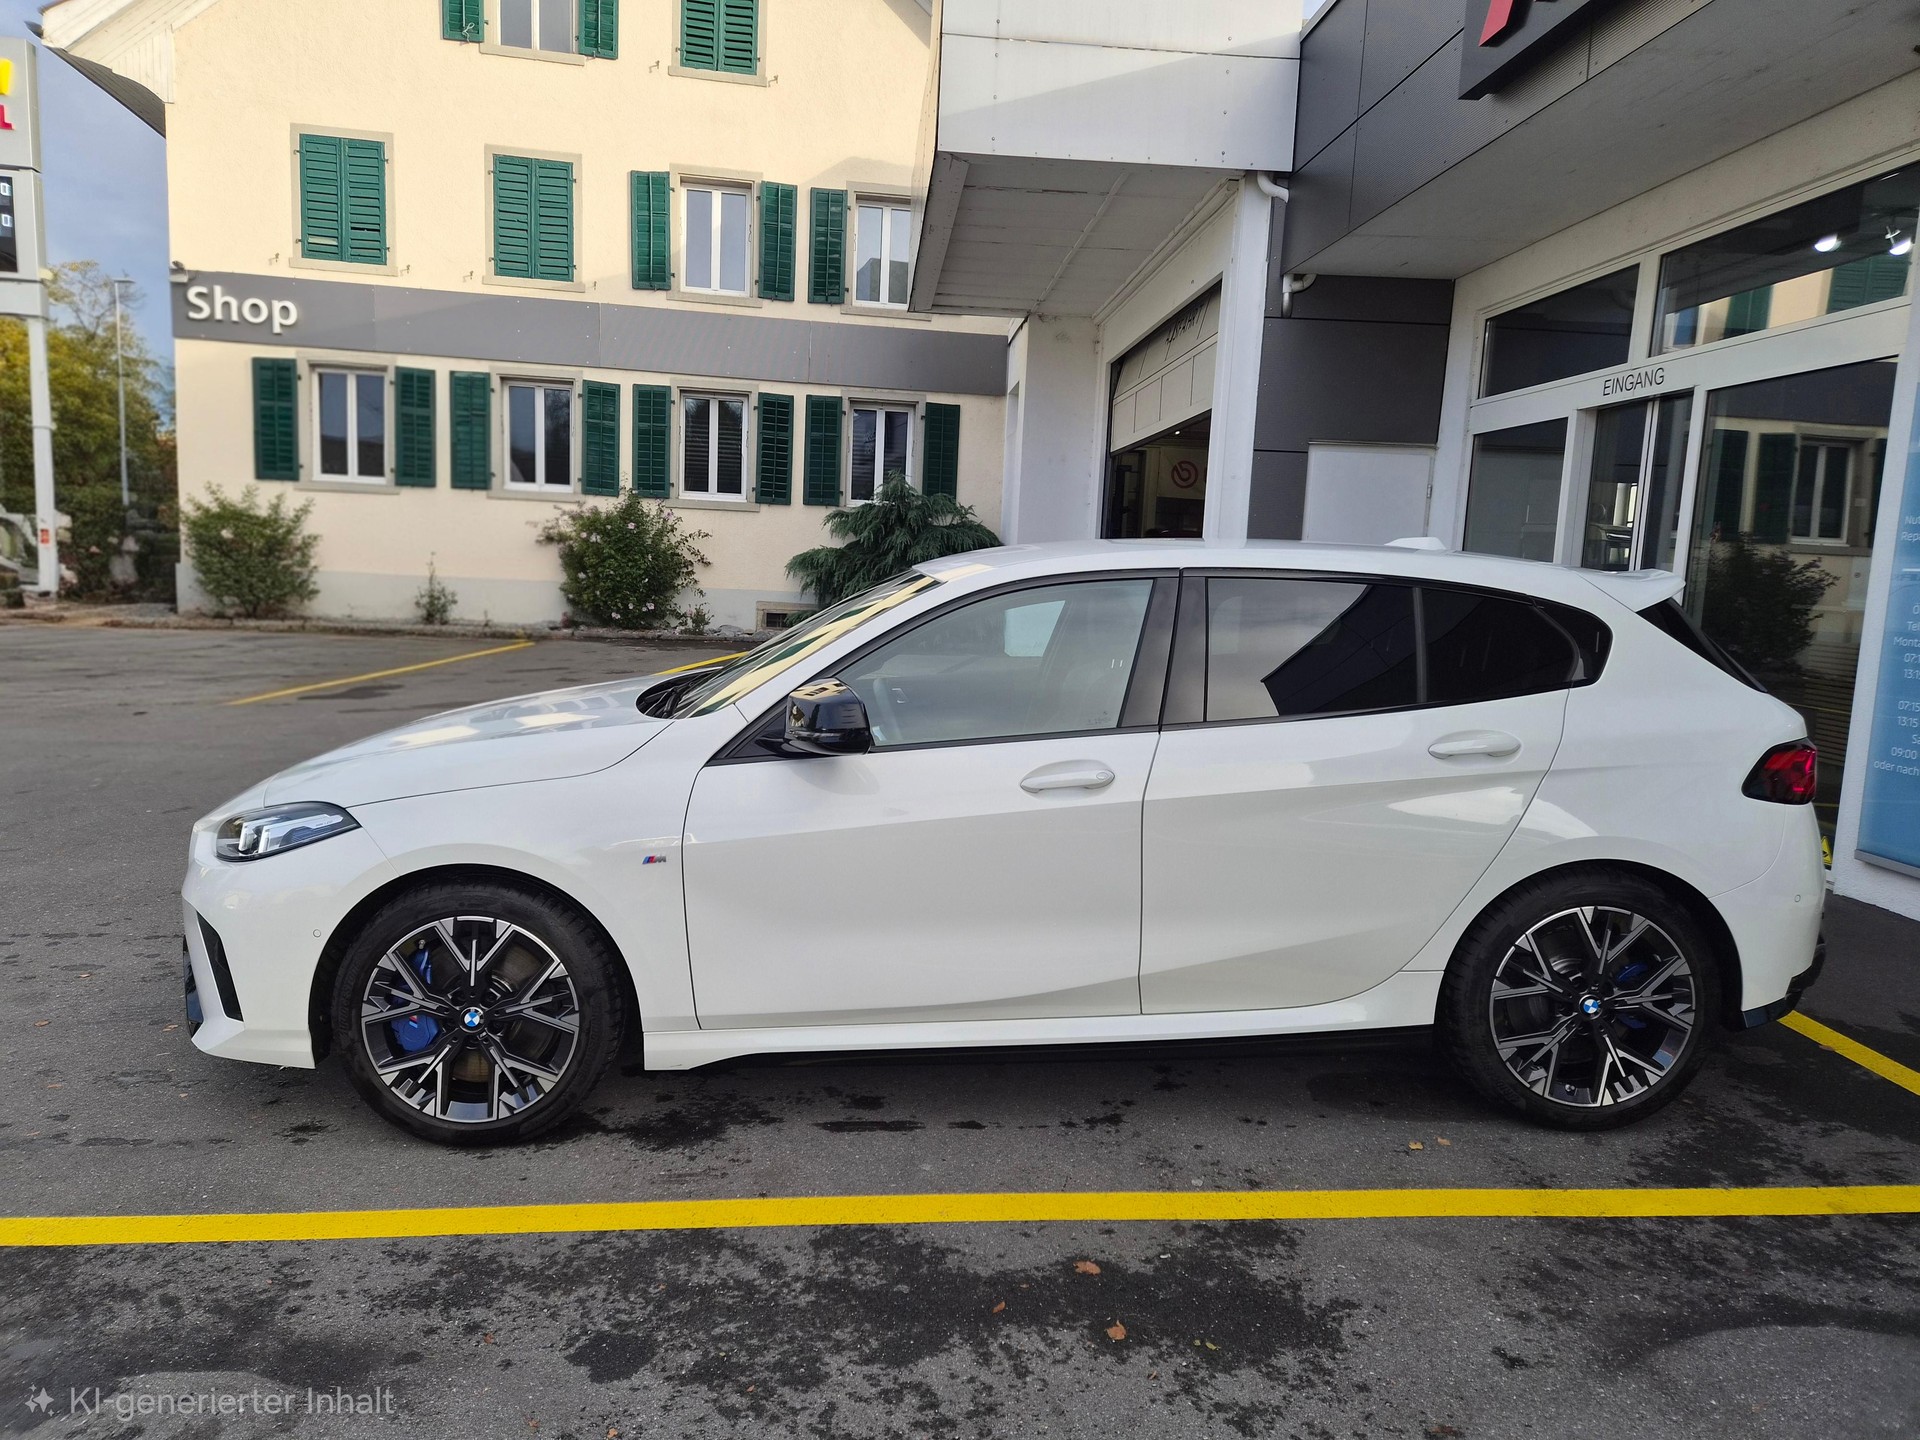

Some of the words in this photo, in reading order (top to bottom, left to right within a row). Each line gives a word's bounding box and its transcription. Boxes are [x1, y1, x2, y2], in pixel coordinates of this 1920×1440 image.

[187, 285, 298, 334] Shop
[1603, 368, 1664, 396] EINGANG
[1873, 760, 1895, 771] oder
[1896, 765, 1919, 776] nach
